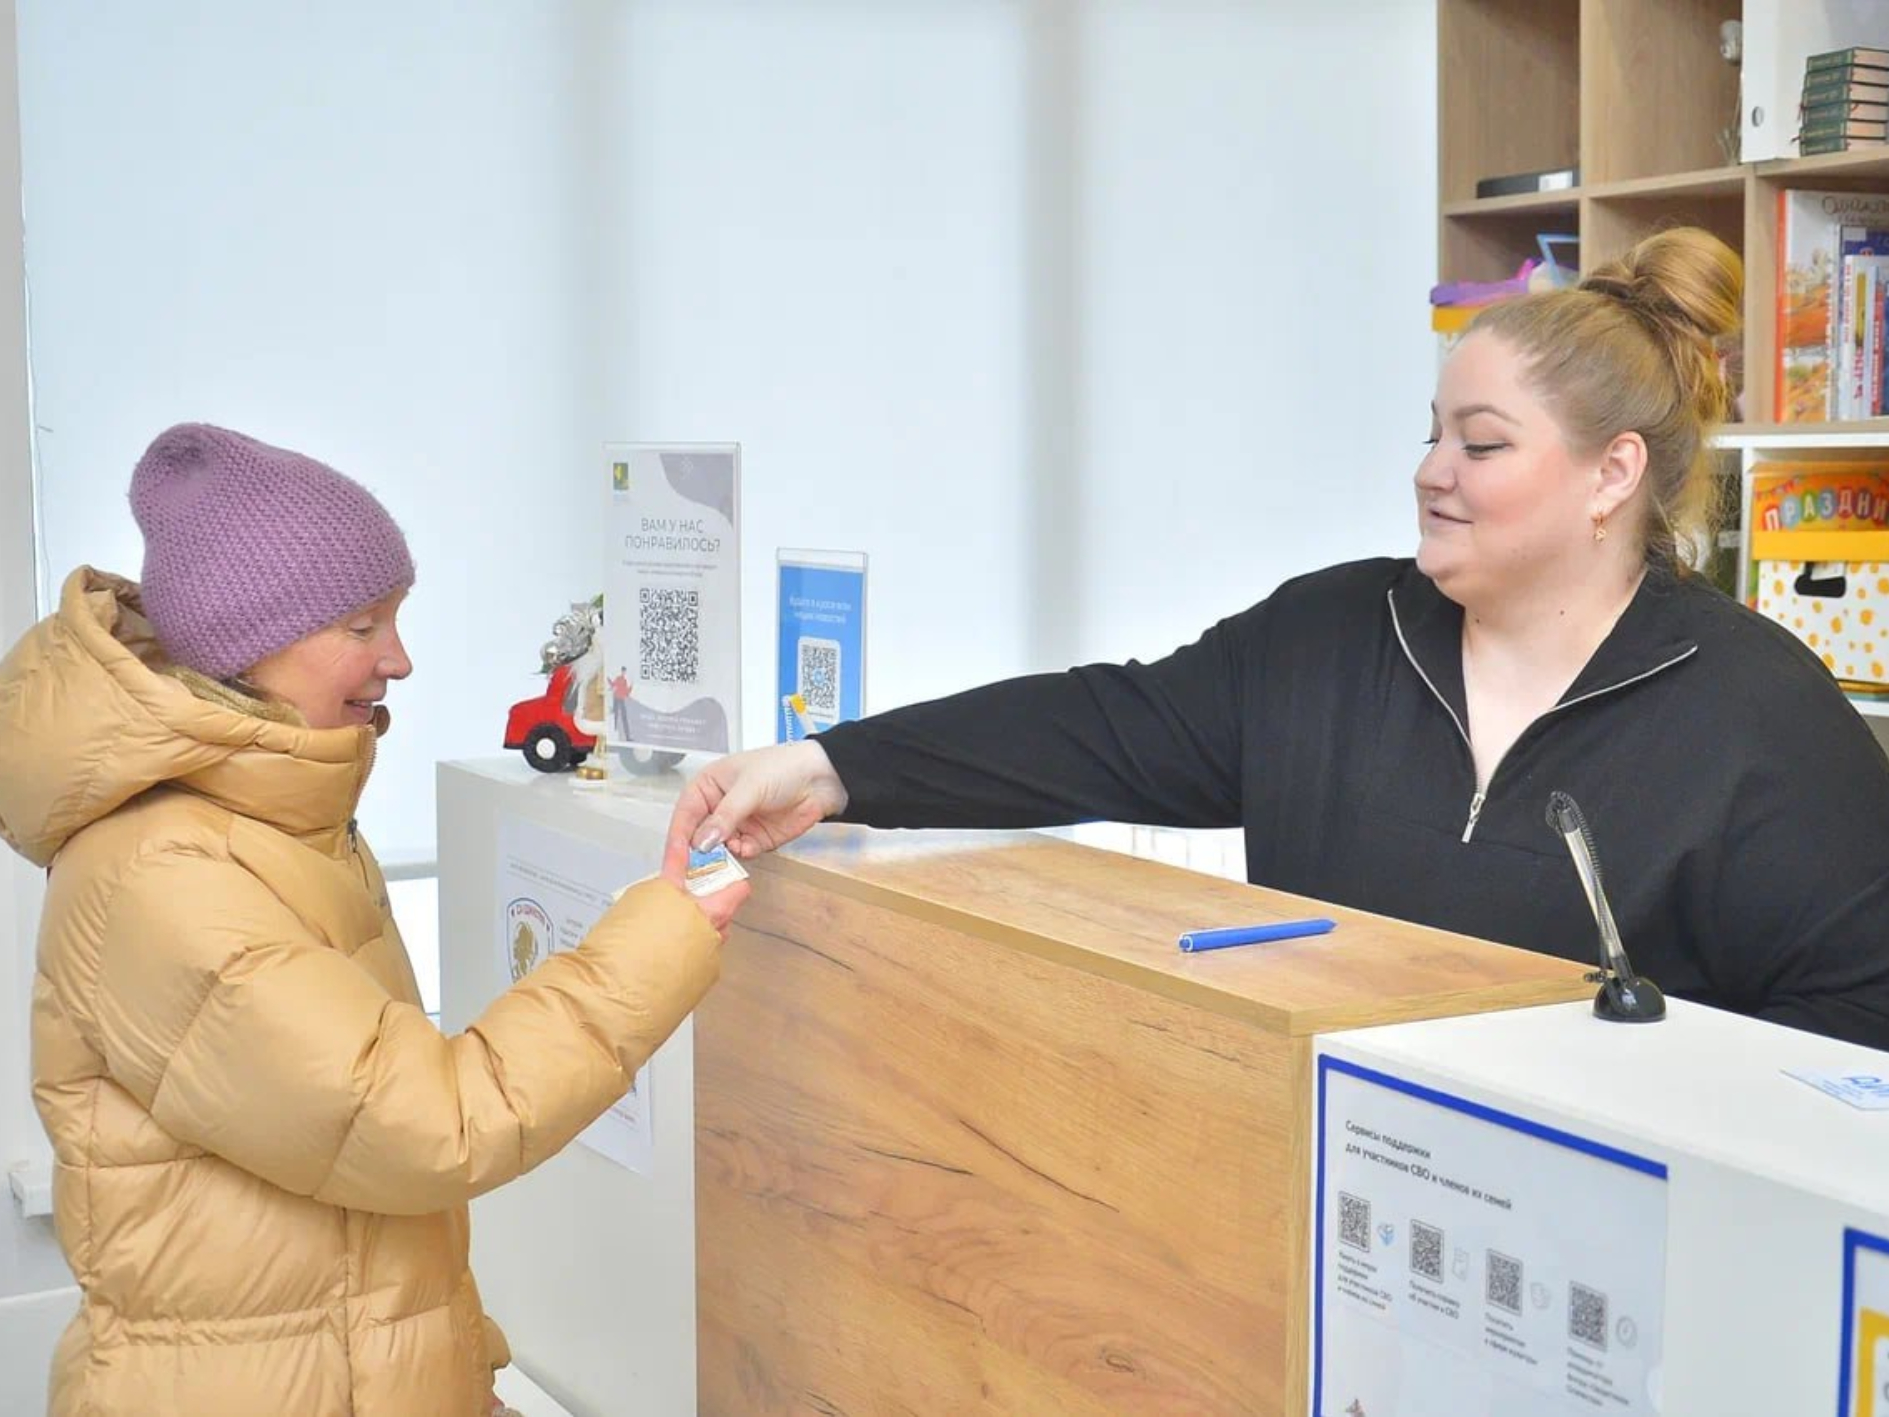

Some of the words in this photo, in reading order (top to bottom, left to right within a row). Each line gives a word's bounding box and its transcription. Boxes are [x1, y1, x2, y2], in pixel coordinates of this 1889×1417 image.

[640, 517, 667, 533] ВАМ
[669, 519, 677, 532] У
[679, 519, 704, 534] НАС
[625, 535, 721, 552] ПОНРАВИЛОСЬ?
[1345, 1119, 1381, 1142] Сервисы
[1382, 1134, 1432, 1160] поддержки
[1345, 1142, 1361, 1156] для
[1410, 1163, 1430, 1181] СВО
